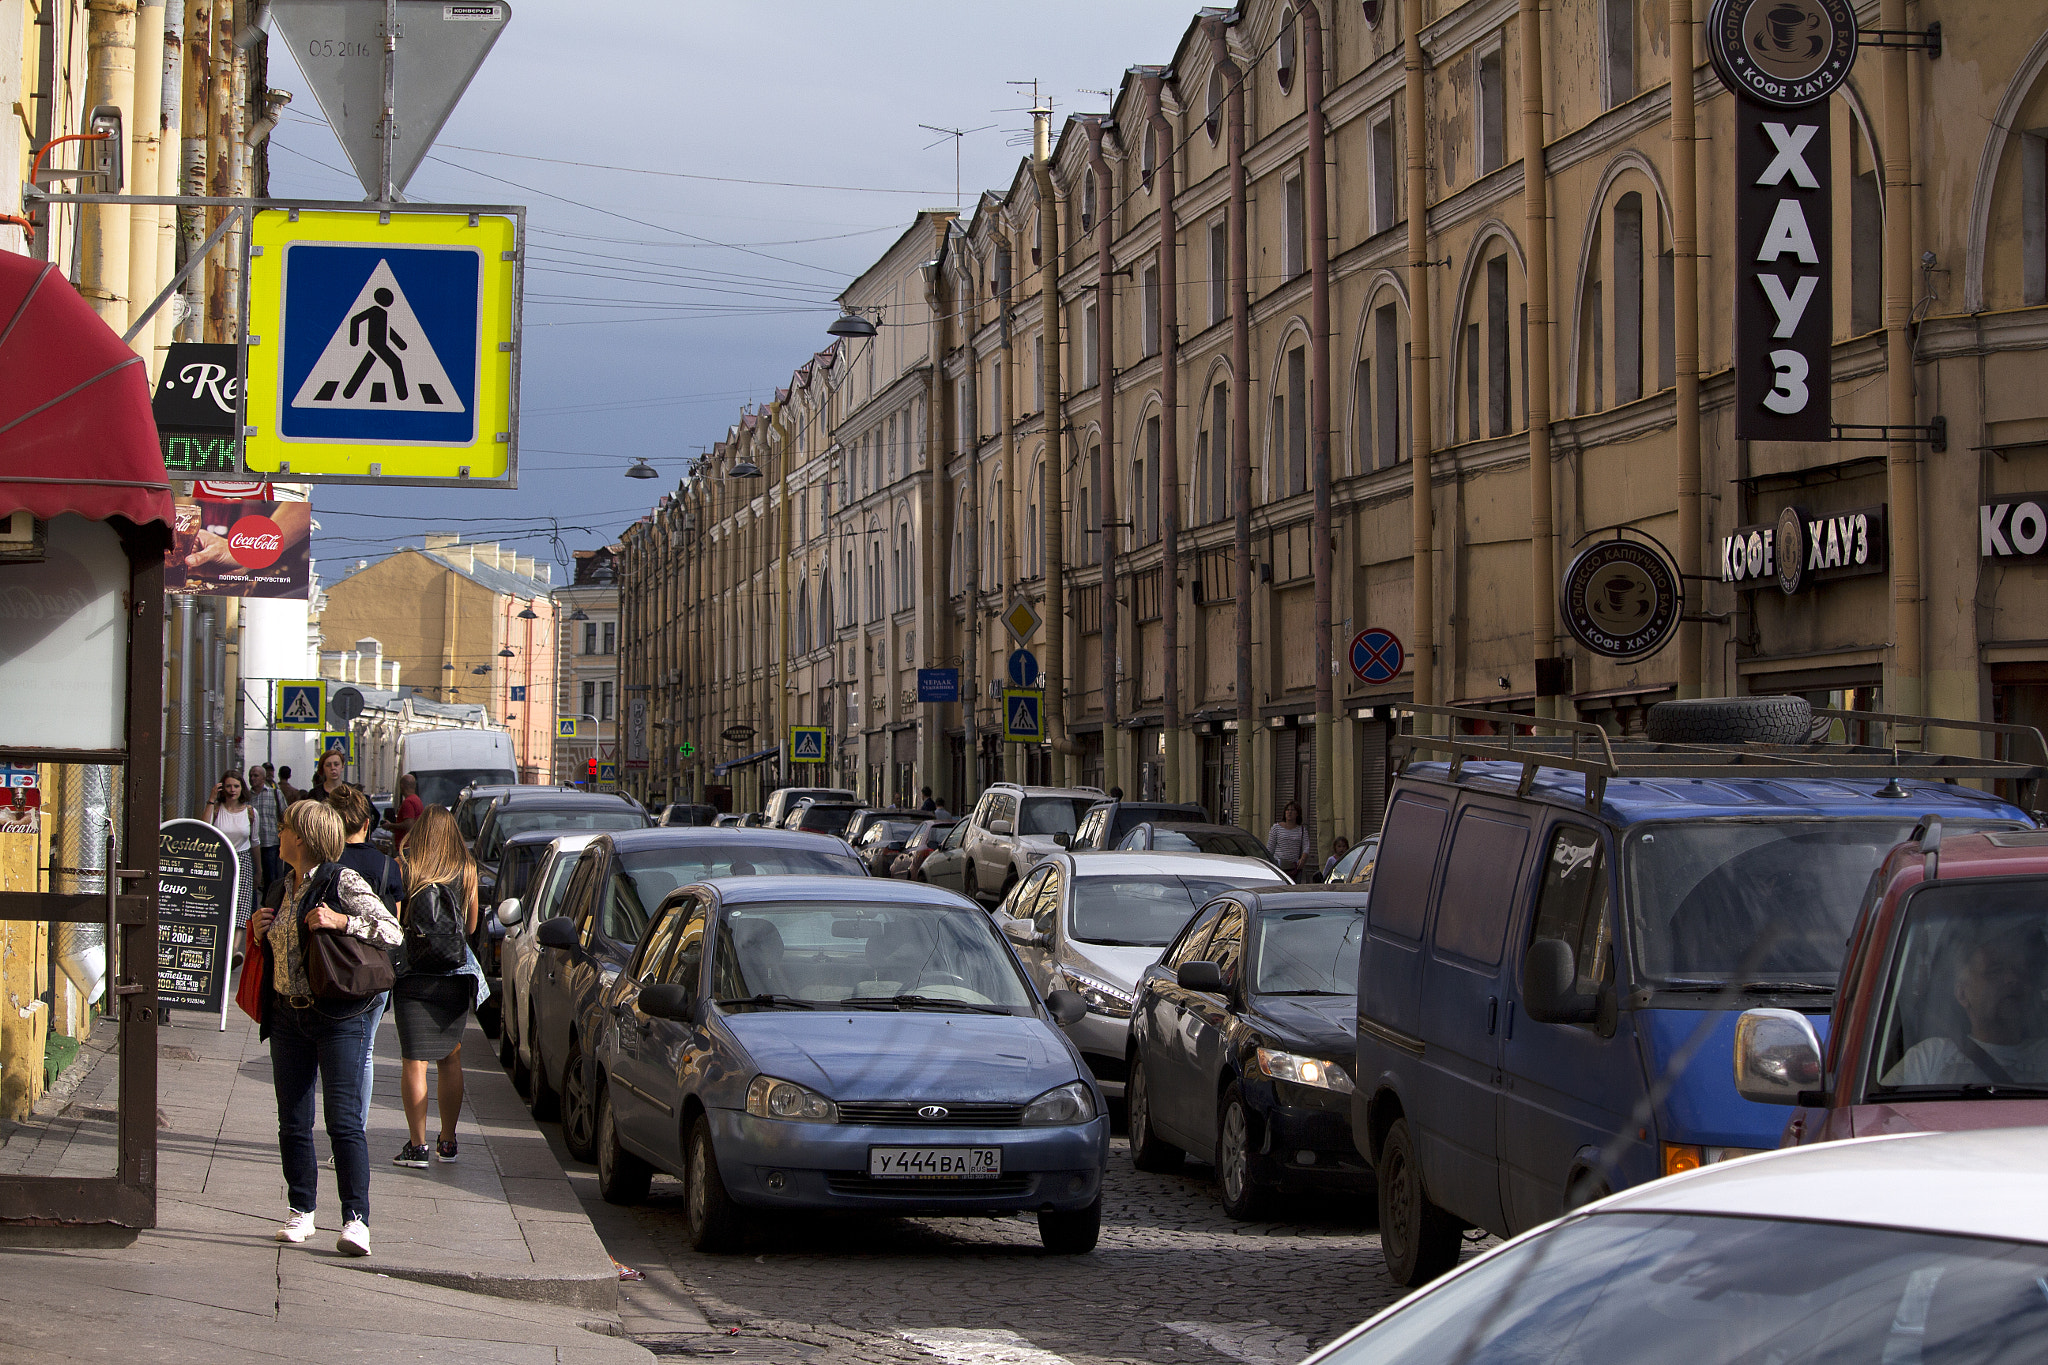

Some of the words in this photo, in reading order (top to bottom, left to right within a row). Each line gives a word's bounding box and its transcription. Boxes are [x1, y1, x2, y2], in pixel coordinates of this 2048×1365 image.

[309, 40, 370, 57] 05.2016
[1836, 30, 1848, 57] БАР
[1743, 67, 1787, 98] КОФЕ
[1793, 70, 1834, 98] ХАУЗ
[1756, 122, 1821, 415] ХАУЗ
[1979, 501, 2047, 556] КО
[230, 532, 282, 551] Coca-Cola
[1721, 528, 1773, 583] КОФЕ
[1808, 513, 1868, 571] ХАУЗ
[1573, 556, 1601, 616] ЭСПРЕССО
[1604, 548, 1667, 588] КАППУЧИНО
[1660, 593, 1670, 616] БАР
[1586, 627, 1620, 650] КОФЕ
[1626, 627, 1658, 650] ХАУЗ
[159, 834, 221, 854] Resident
[180, 952, 205, 965] ГРИЛЬ
[974, 1150, 994, 1166] 78
